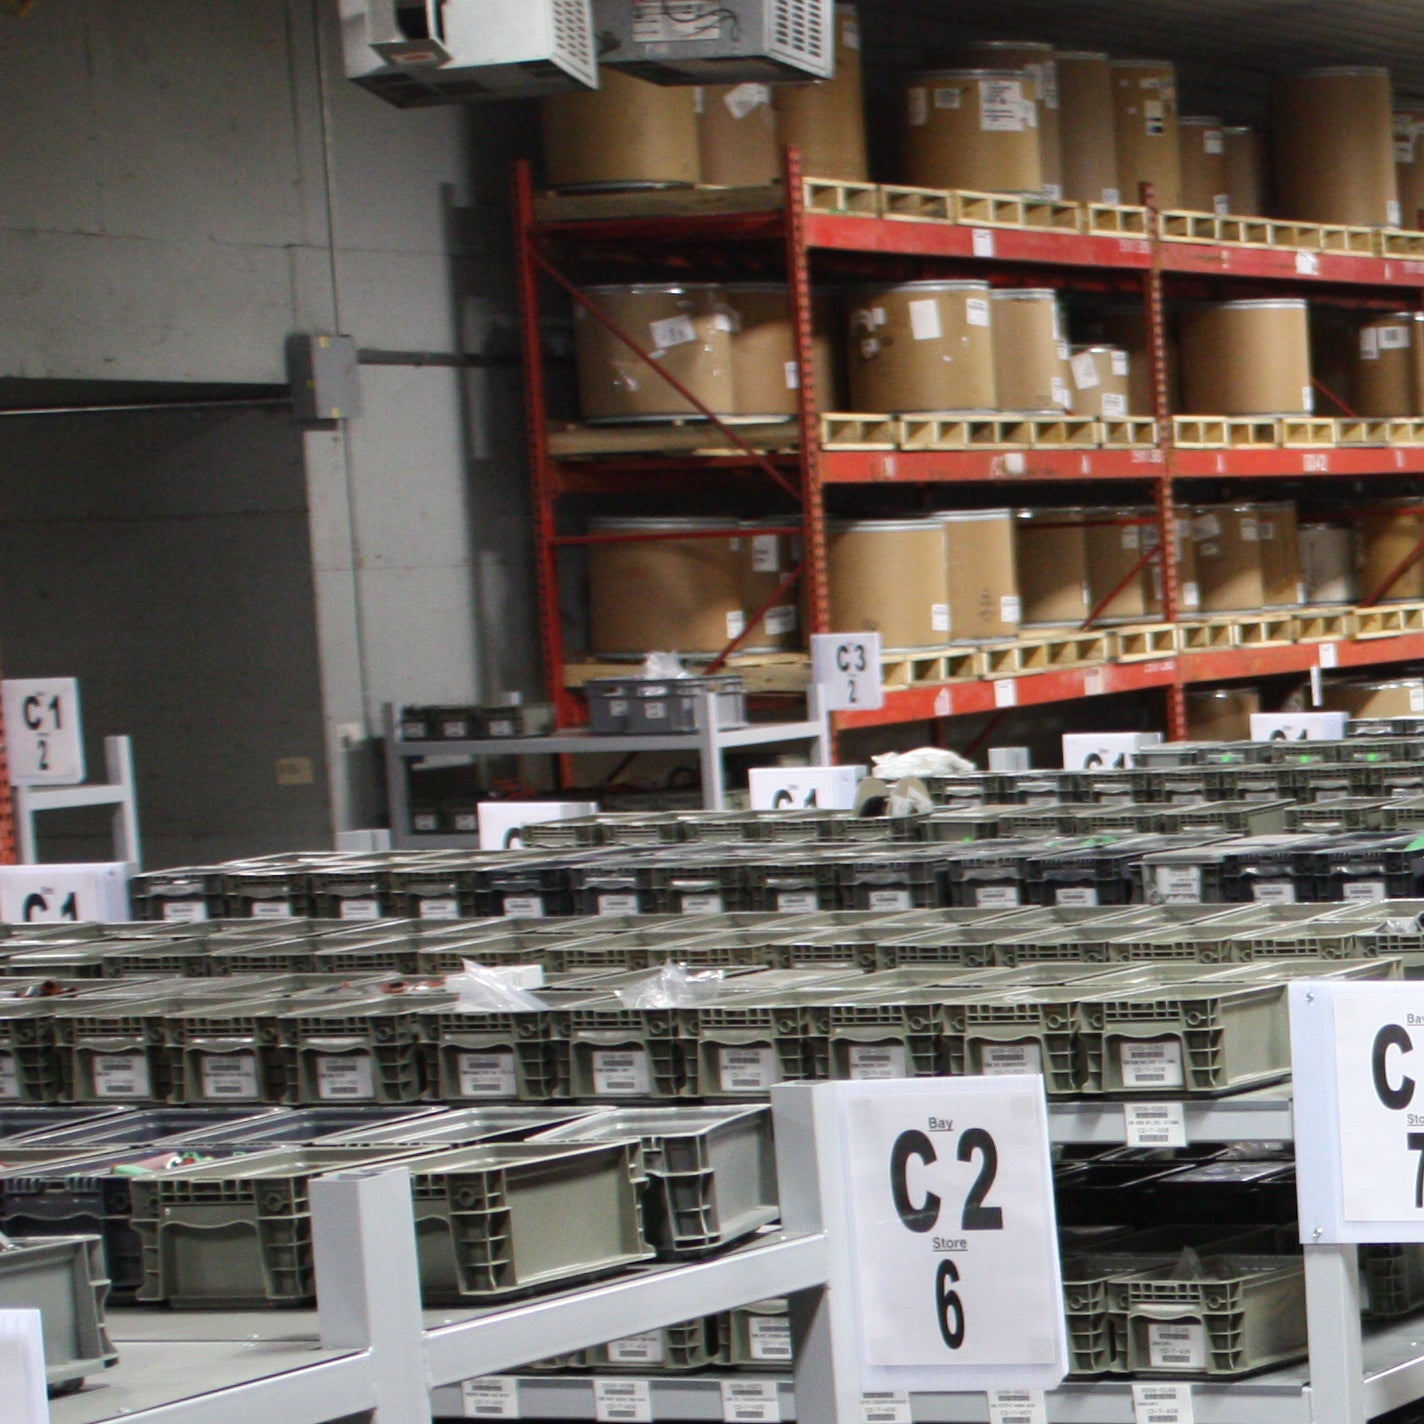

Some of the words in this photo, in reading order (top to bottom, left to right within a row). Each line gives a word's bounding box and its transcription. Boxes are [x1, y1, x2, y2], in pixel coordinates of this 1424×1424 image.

[846, 679, 857, 704] 2
[37, 739, 49, 771] 2
[928, 1116, 954, 1131] Bay
[931, 1236, 968, 1251] Store
[935, 1258, 966, 1350] 6
